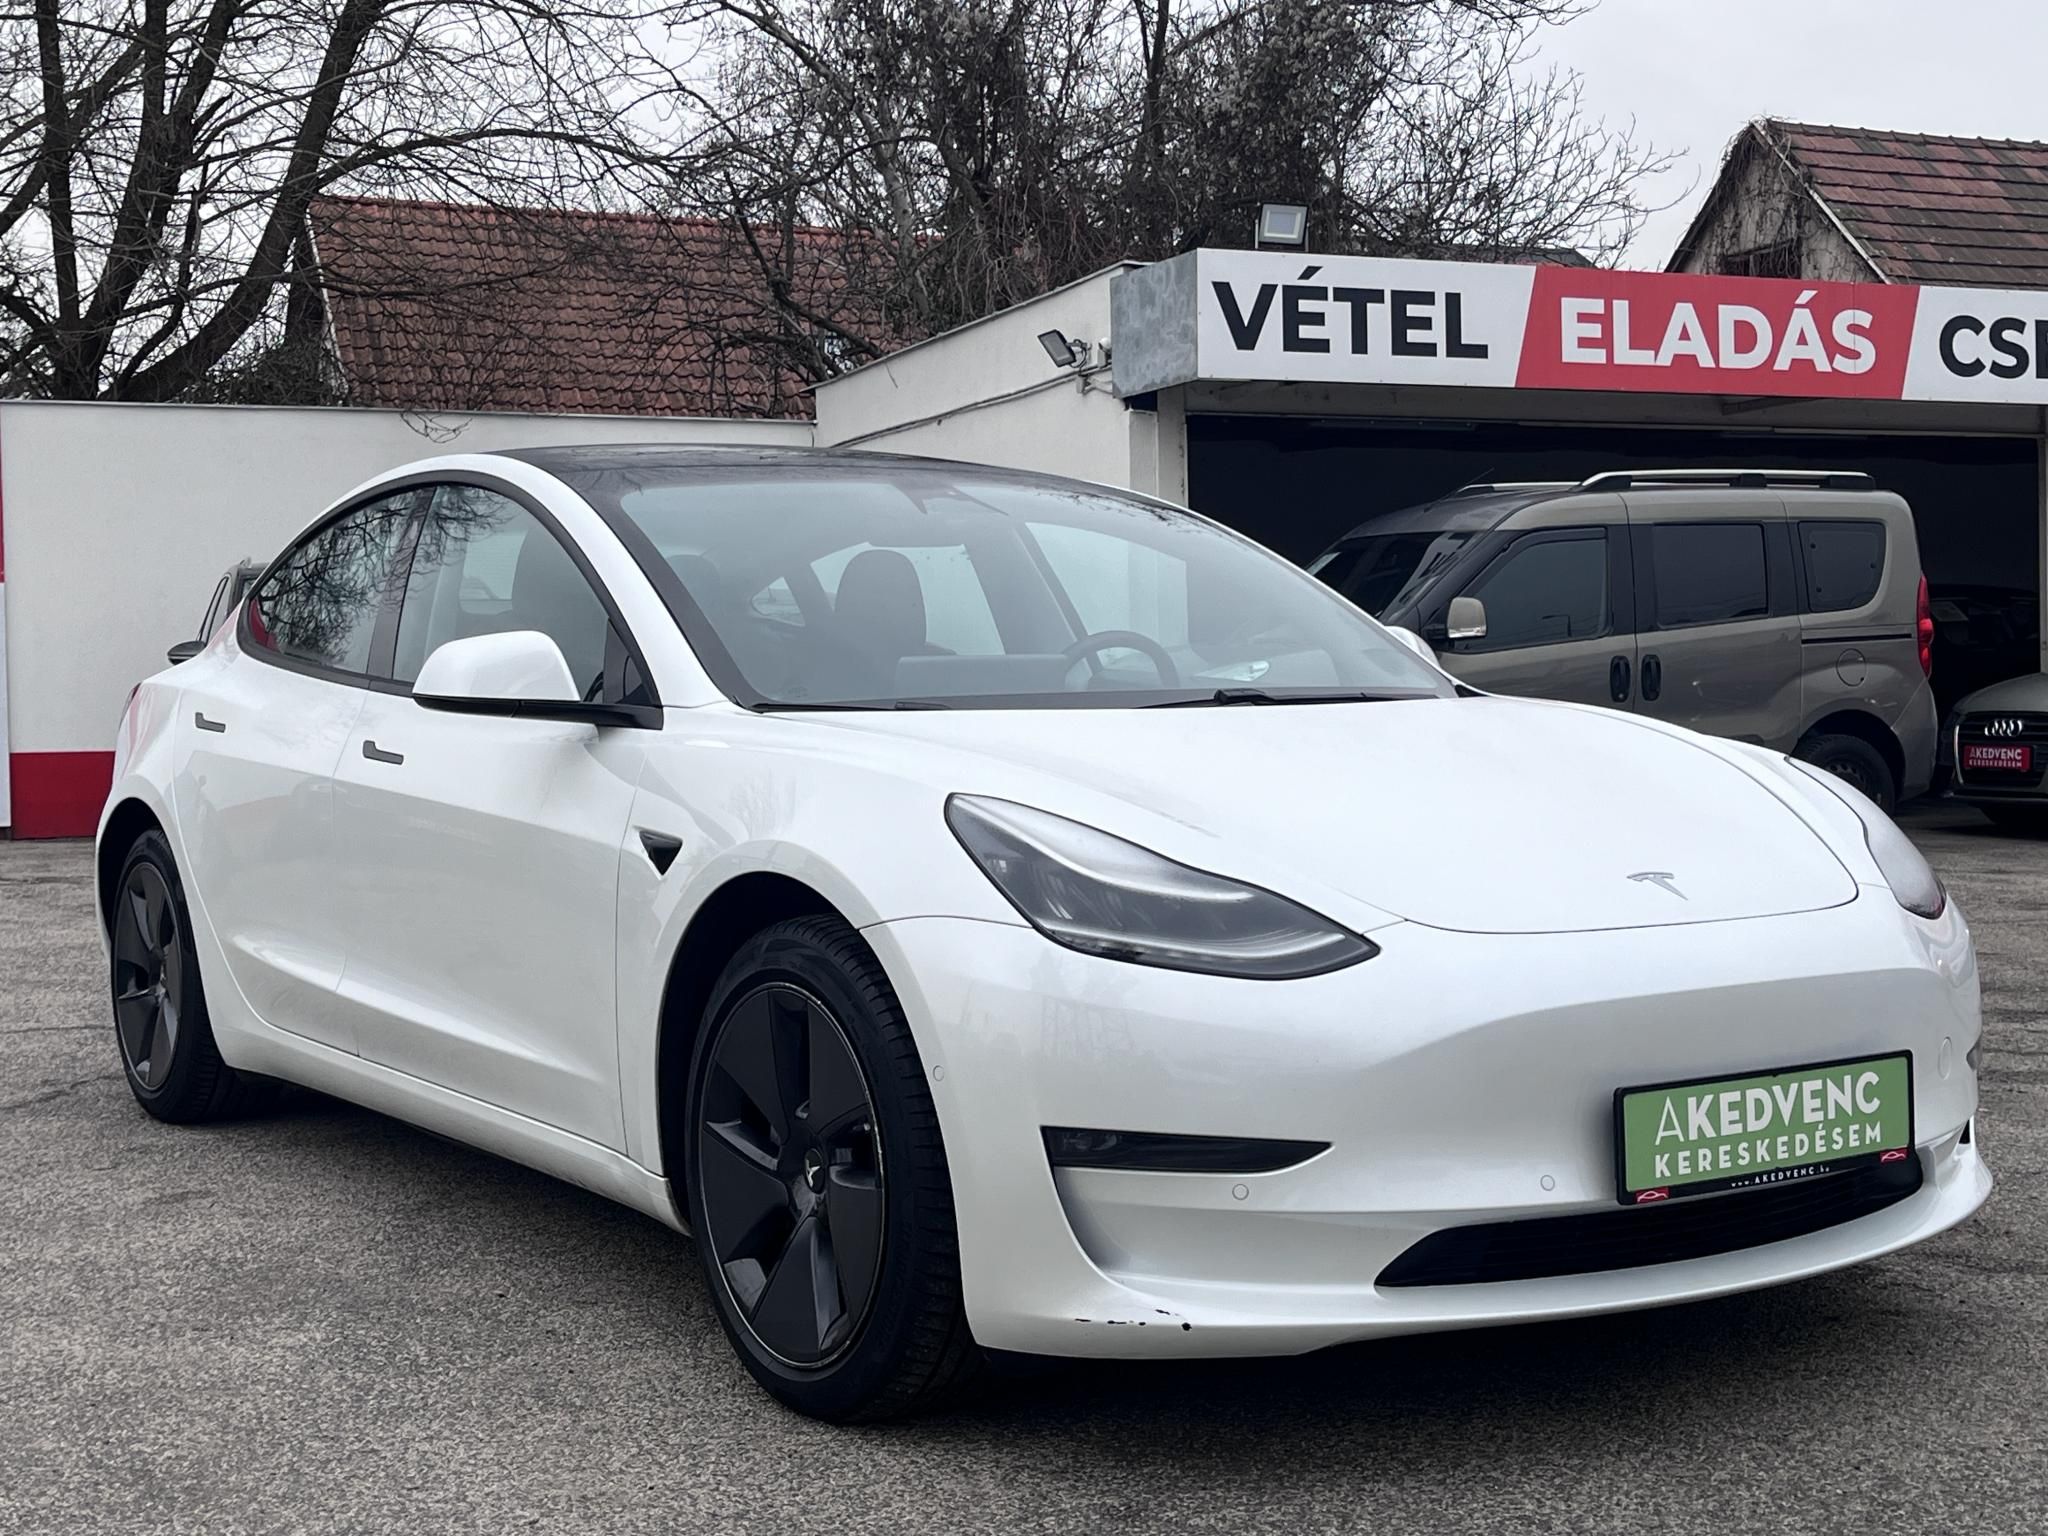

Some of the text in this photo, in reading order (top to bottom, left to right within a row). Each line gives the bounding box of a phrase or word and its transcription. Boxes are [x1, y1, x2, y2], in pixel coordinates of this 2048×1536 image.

[1211, 265, 1489, 359] VÉTEL
[1560, 289, 1877, 374] ELADÁS
[1654, 1071, 1882, 1146] AKEDVENC
[1654, 1121, 1883, 1179] KERESKEDÉSEM
